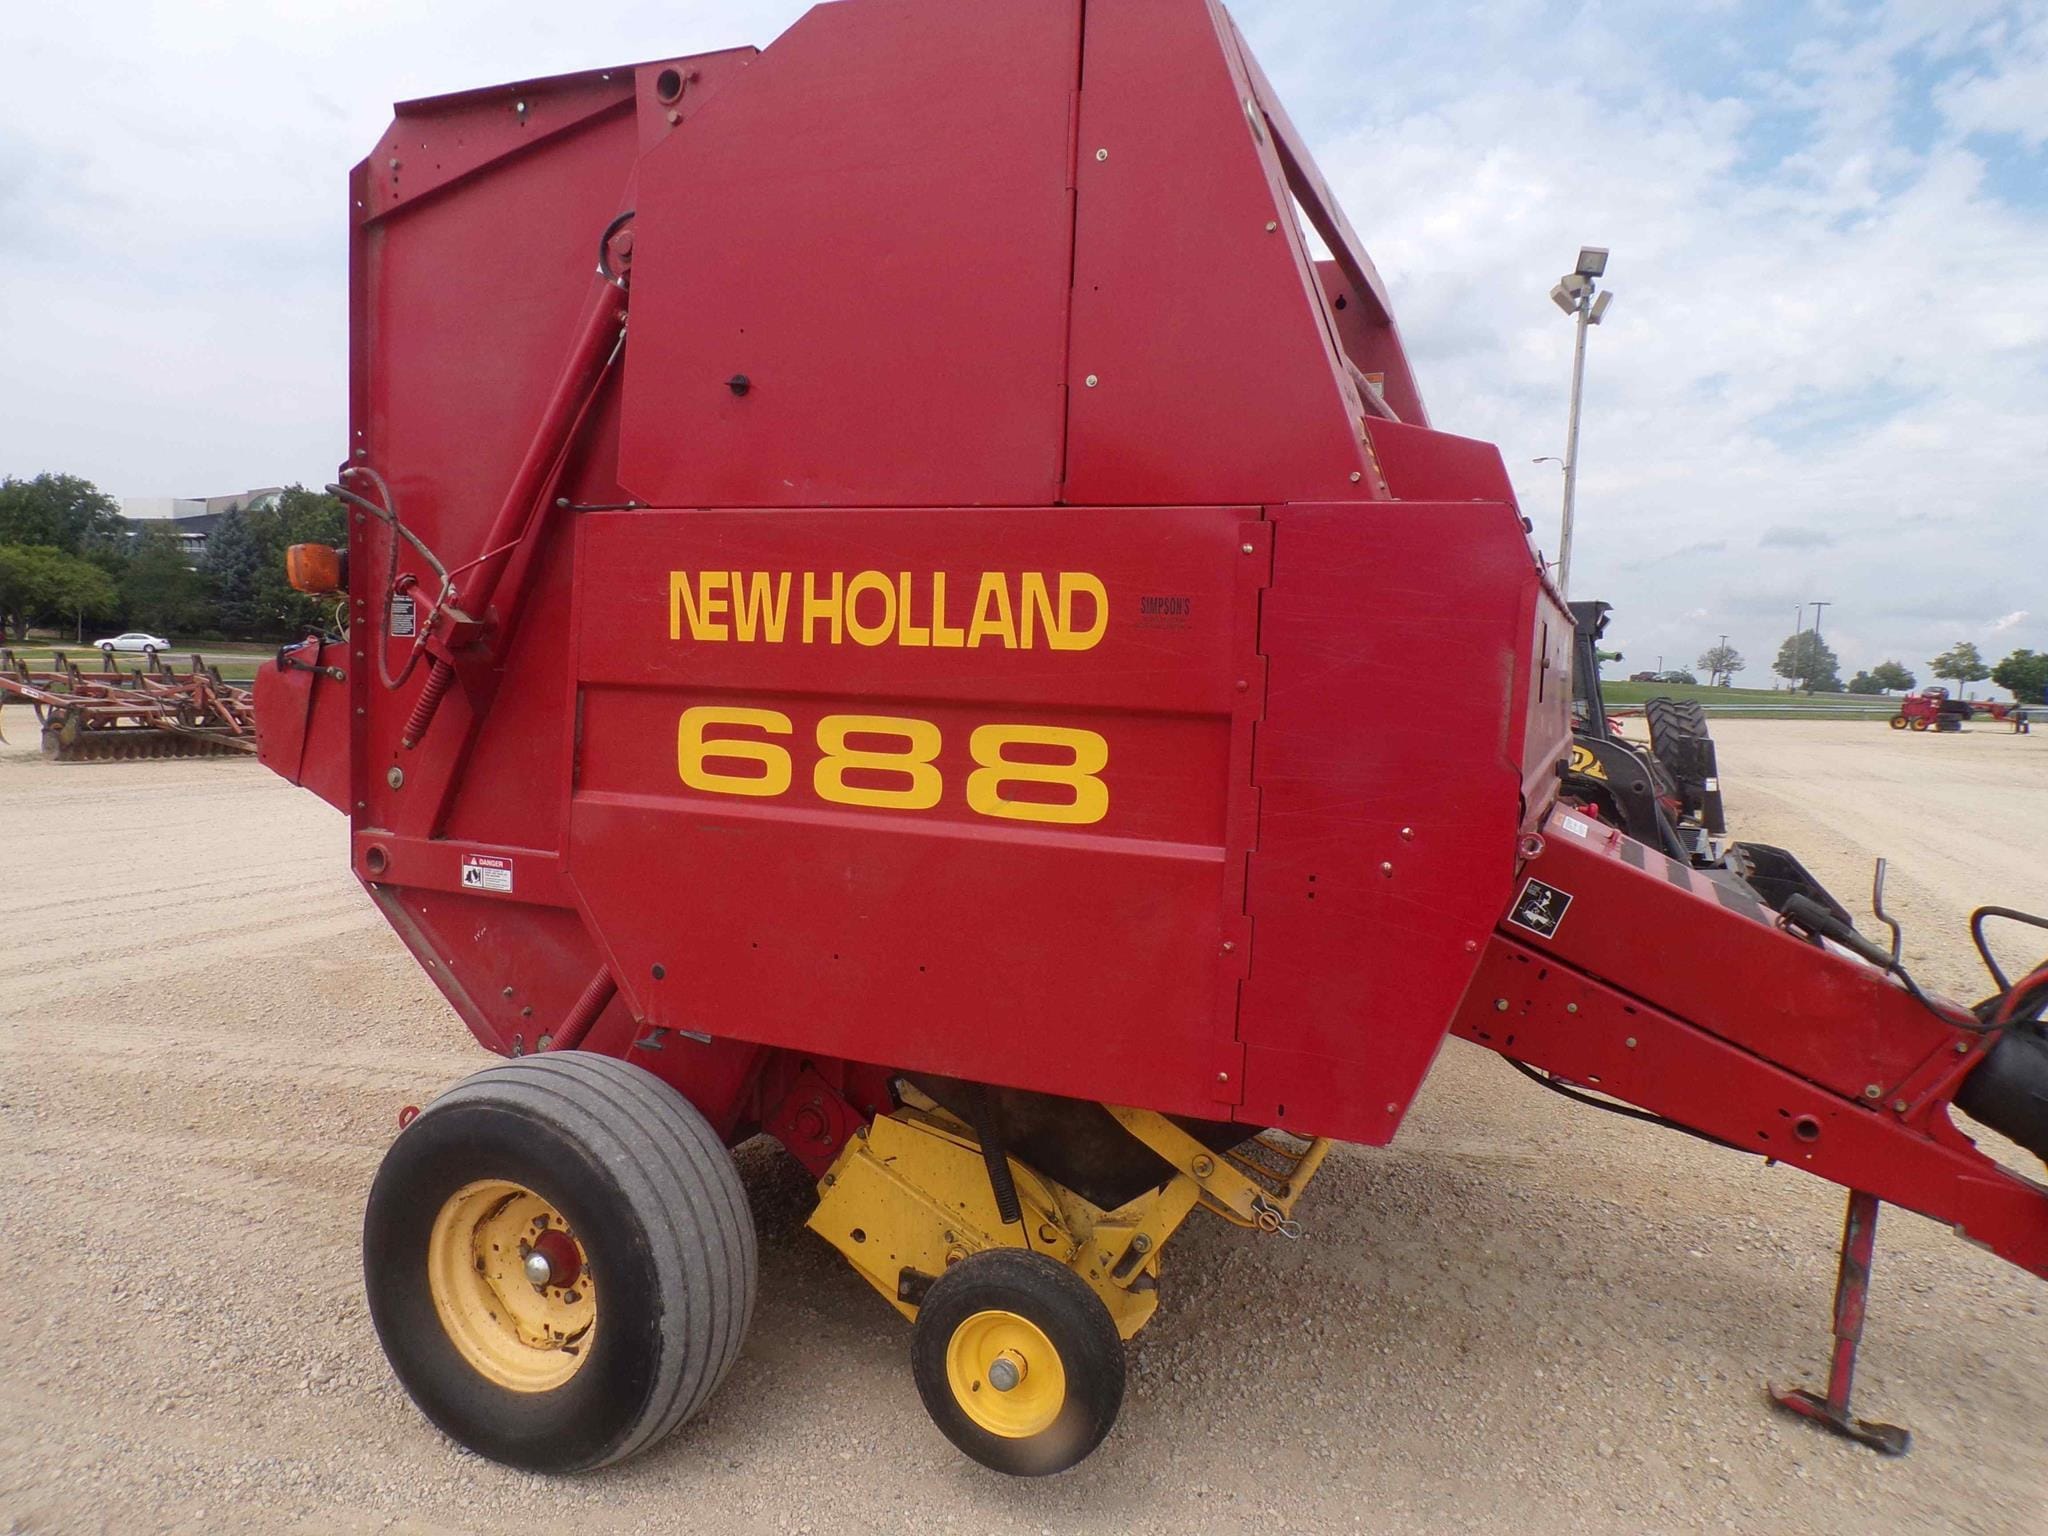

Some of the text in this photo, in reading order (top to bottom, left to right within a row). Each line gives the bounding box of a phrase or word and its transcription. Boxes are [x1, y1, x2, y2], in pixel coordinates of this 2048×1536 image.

[669, 570, 1108, 650] NEW HOLLAND
[1140, 596, 1190, 616] SIMPSON'S
[677, 706, 1108, 824] 688
[479, 859, 503, 868] DANGER
